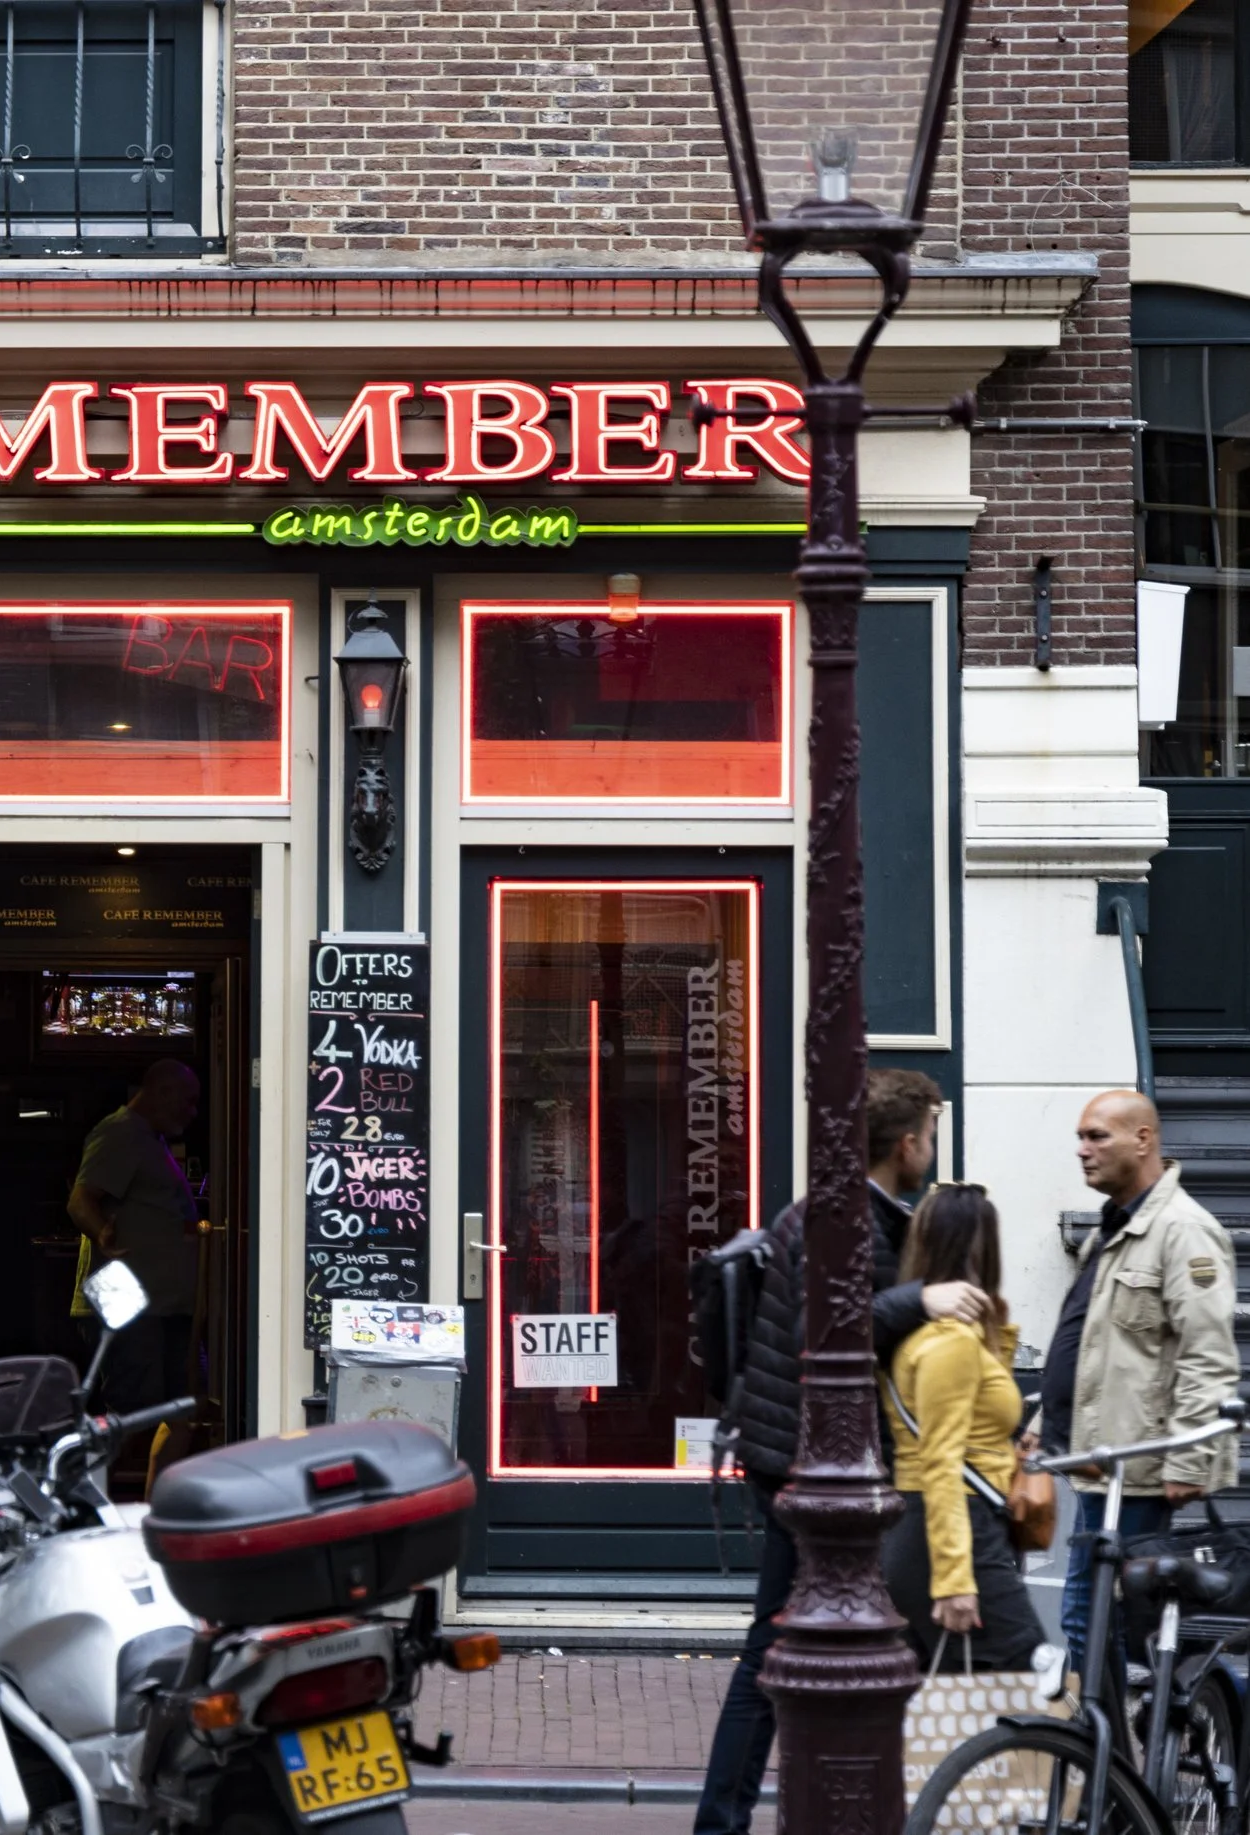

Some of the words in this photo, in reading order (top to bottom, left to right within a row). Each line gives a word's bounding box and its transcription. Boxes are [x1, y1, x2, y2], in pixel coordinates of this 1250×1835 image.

[266, 494, 575, 544] amsterdam
[123, 613, 274, 700] BAR
[20, 875, 56, 886] CAFE
[60, 876, 140, 887] REMEMBER
[88, 886, 141, 894] amsterdam
[187, 876, 224, 888] CAFE
[4, 919, 57, 927] amsterdam
[103, 909, 140, 920] CAFE
[143, 909, 223, 921] REMEMBER
[171, 920, 224, 928] amsterdam
[351, 978, 368, 986] TO
[309, 990, 413, 1011] REMEMBER
[312, 1019, 353, 1063] 4
[353, 1023, 422, 1069] VODKA
[718, 958, 745, 1136] amsterdam
[315, 1066, 356, 1113] 2
[359, 1068, 414, 1093] RED
[360, 1091, 414, 1112] BULL
[687, 958, 720, 1234] REMEMBER
[340, 1115, 382, 1142] 28
[306, 1151, 340, 1195] 10
[347, 1182, 421, 1212] BOMBS
[320, 1209, 365, 1239] 30
[309, 1252, 329, 1267] 10
[335, 1253, 390, 1265] SHOTS
[324, 1266, 365, 1289] 20
[520, 1322, 609, 1354] STAFF
[521, 1356, 610, 1382] WANTED
[321, 1721, 370, 1762] MJ
